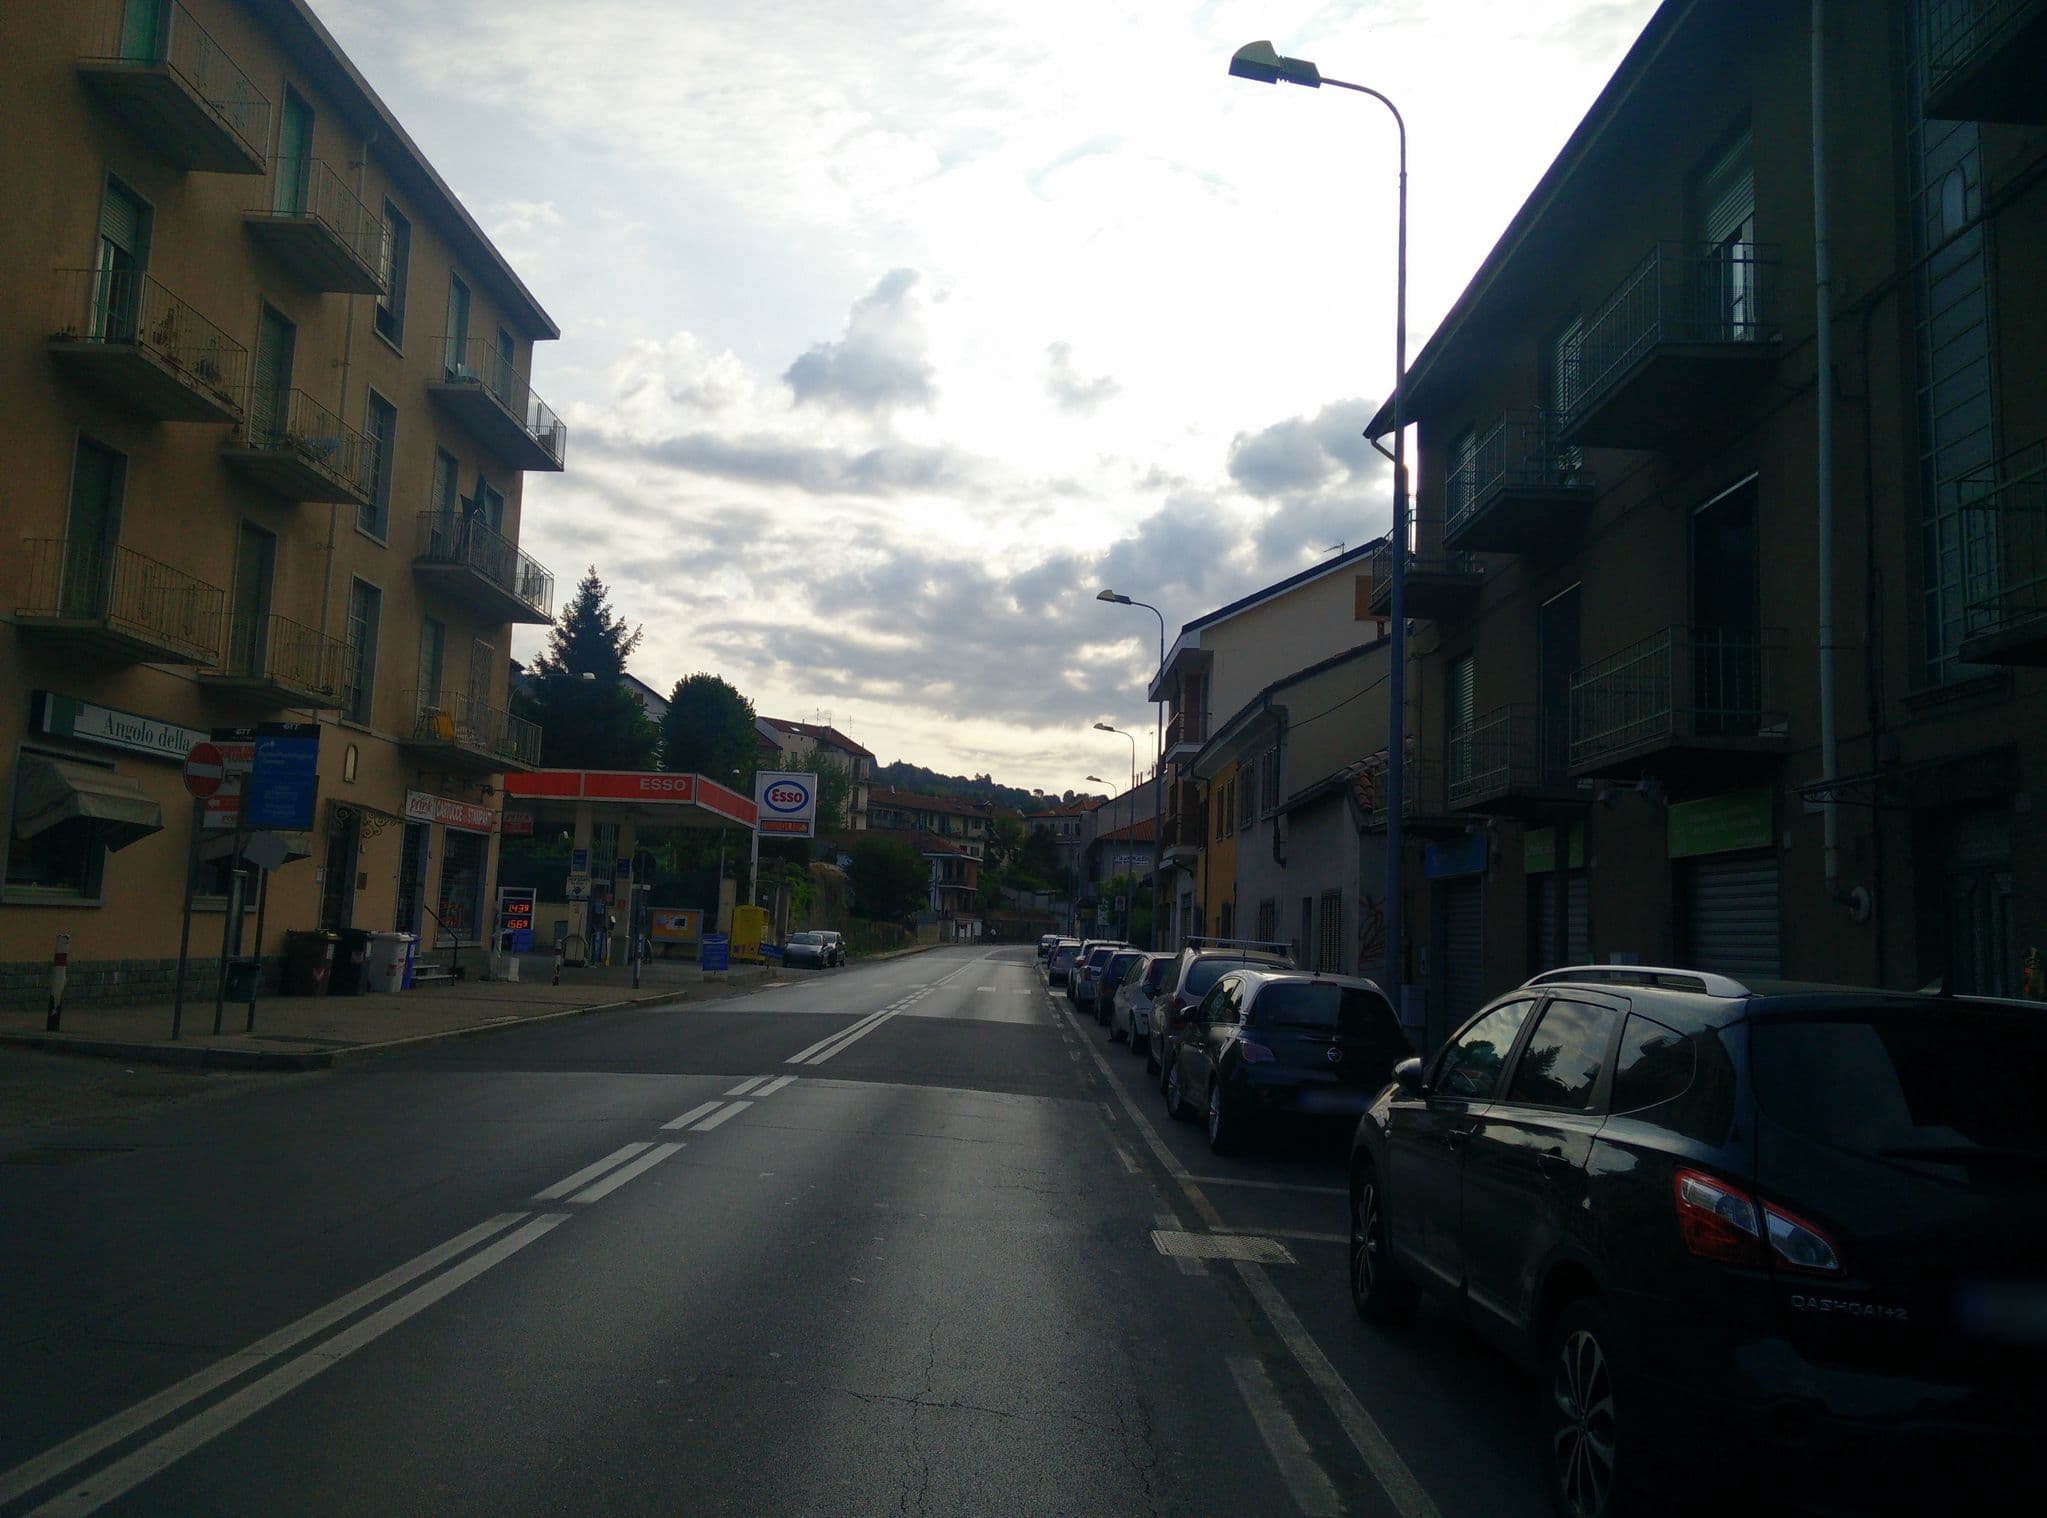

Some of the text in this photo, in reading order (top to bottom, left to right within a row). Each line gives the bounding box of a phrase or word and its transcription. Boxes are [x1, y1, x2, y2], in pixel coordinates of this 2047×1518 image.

[104, 712, 190, 751] Angolo della
[640, 778, 687, 791] ESSO
[771, 788, 803, 803] Esso
